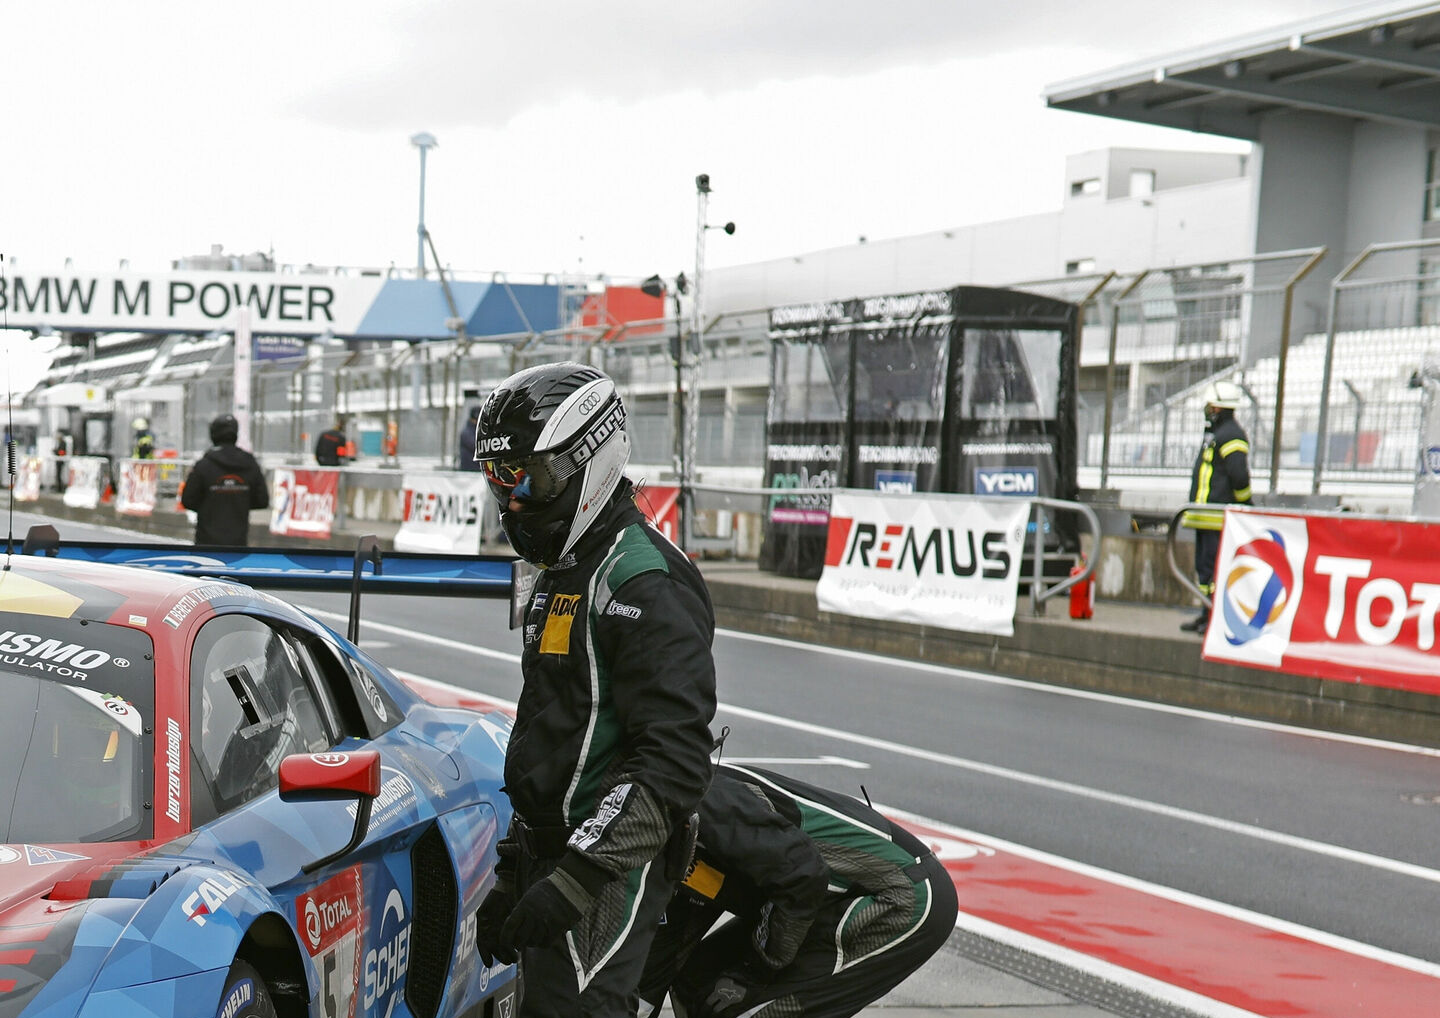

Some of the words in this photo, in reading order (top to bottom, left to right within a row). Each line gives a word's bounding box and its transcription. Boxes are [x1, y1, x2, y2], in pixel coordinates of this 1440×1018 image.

[112, 279, 152, 317] M
[167, 282, 336, 322] POWER
[477, 434, 511, 453] uvex
[980, 473, 1035, 493] YCM
[413, 493, 476, 525] REMUS
[846, 523, 1010, 579] REMUS
[171, 594, 199, 622] BERETTA
[607, 600, 642, 620] freem
[165, 717, 182, 823] berzerkdesign
[319, 895, 352, 932] TOTAL
